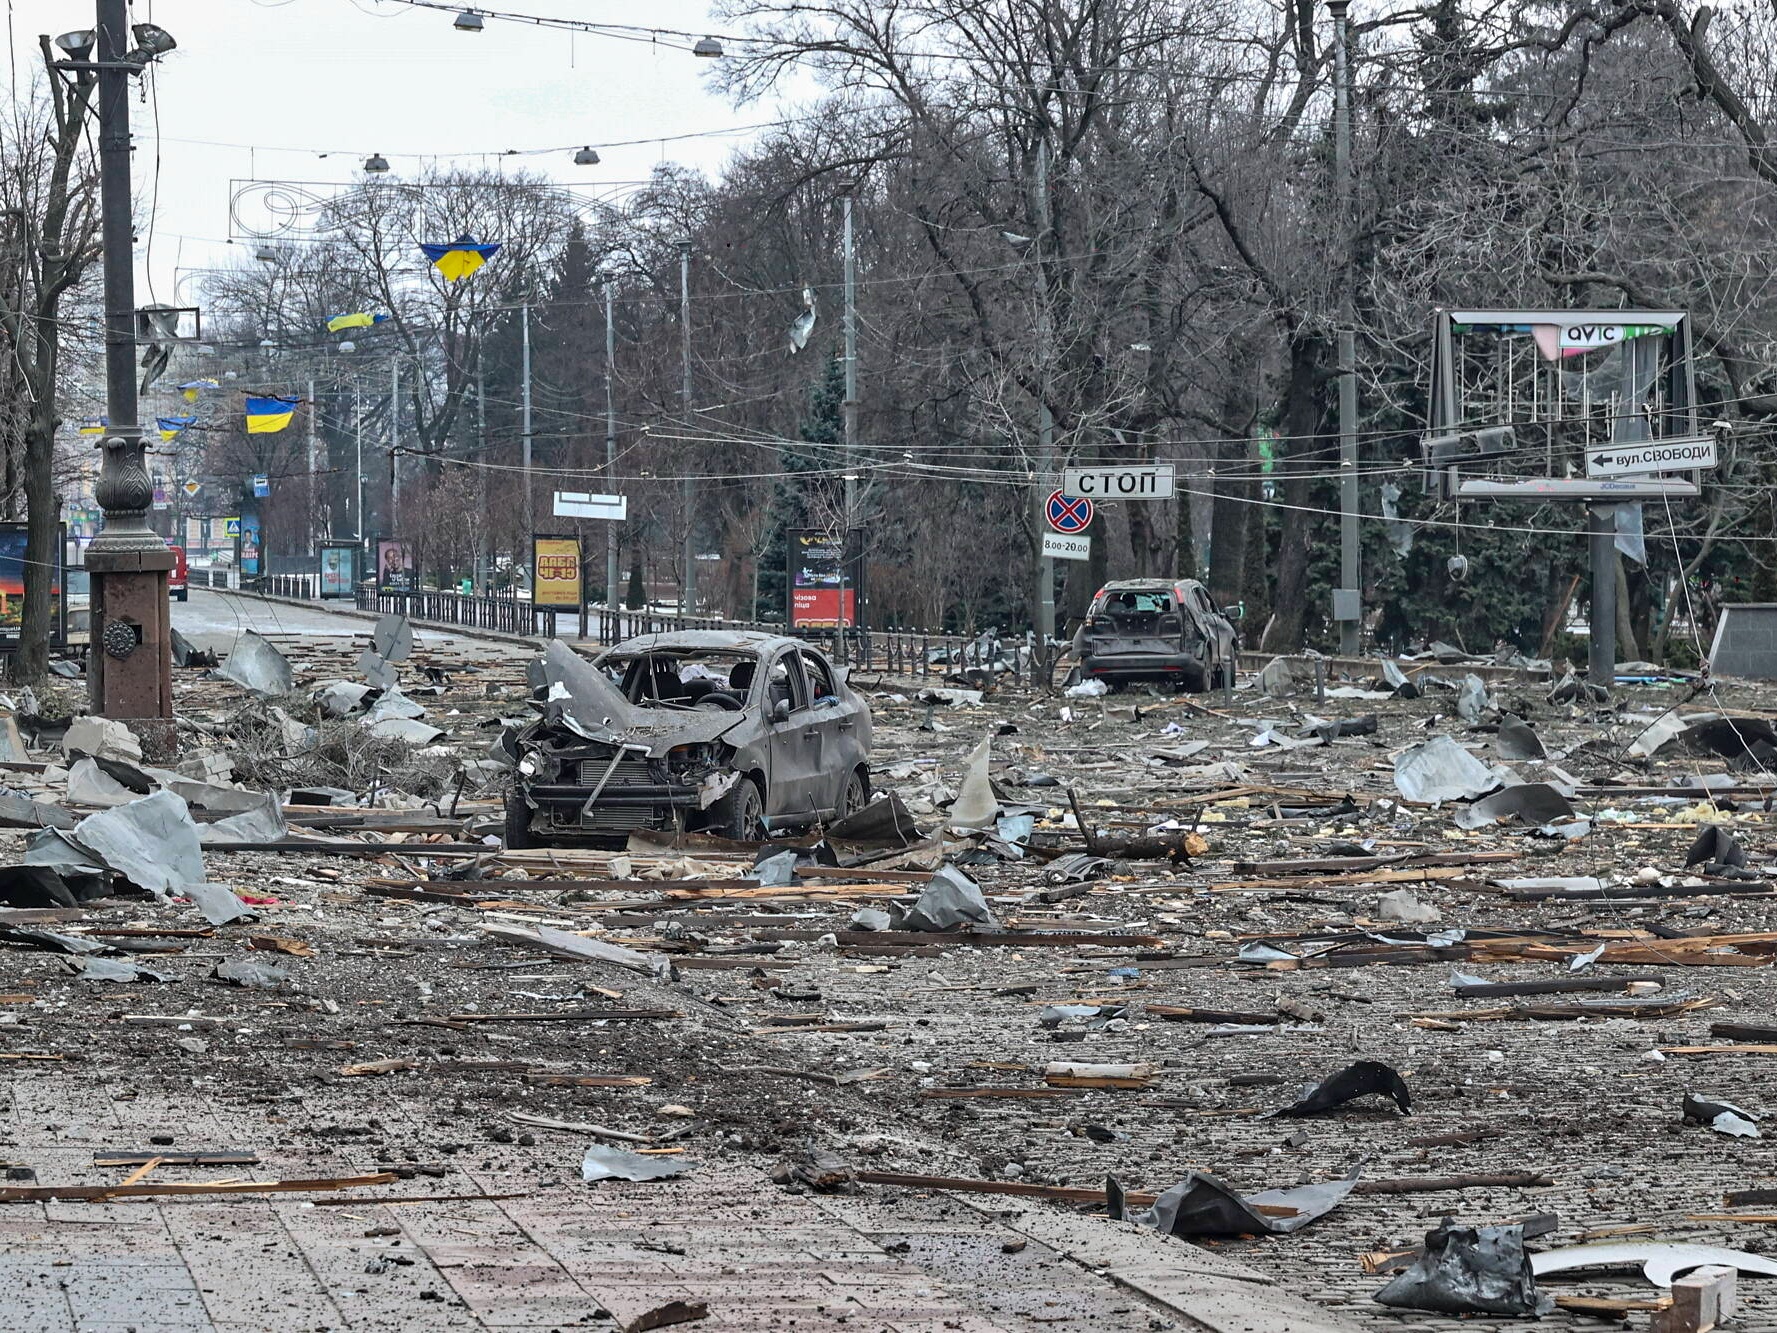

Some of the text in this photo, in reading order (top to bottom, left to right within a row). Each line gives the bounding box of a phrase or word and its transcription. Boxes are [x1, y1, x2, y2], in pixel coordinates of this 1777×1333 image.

[1616, 446, 1711, 467] вул.СВОБОДИ
[1079, 473, 1156, 493] СТОП
[1044, 540, 1088, 553] 8.00-20.00
